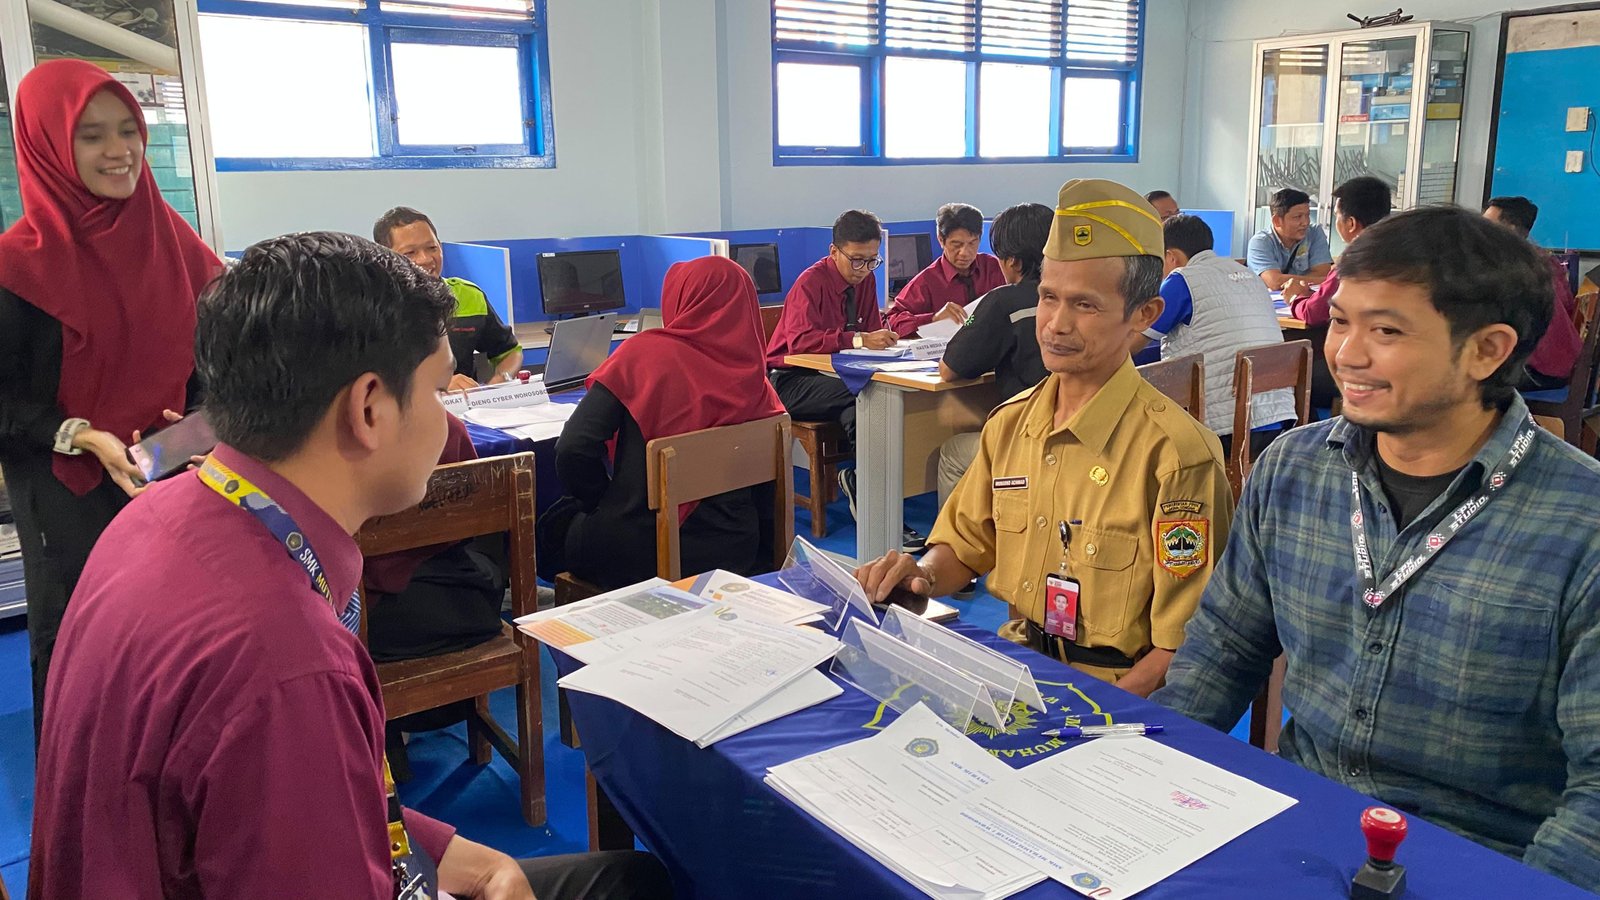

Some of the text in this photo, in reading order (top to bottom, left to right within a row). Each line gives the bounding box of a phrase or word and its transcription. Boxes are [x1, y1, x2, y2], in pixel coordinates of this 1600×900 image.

[471, 398, 492, 407] DIENG
[492, 394, 513, 403] CYBER
[1508, 432, 1527, 457] LPX
[1452, 496, 1477, 522] LPX
[299, 548, 320, 577] SMK
[1393, 555, 1416, 579] LPX
